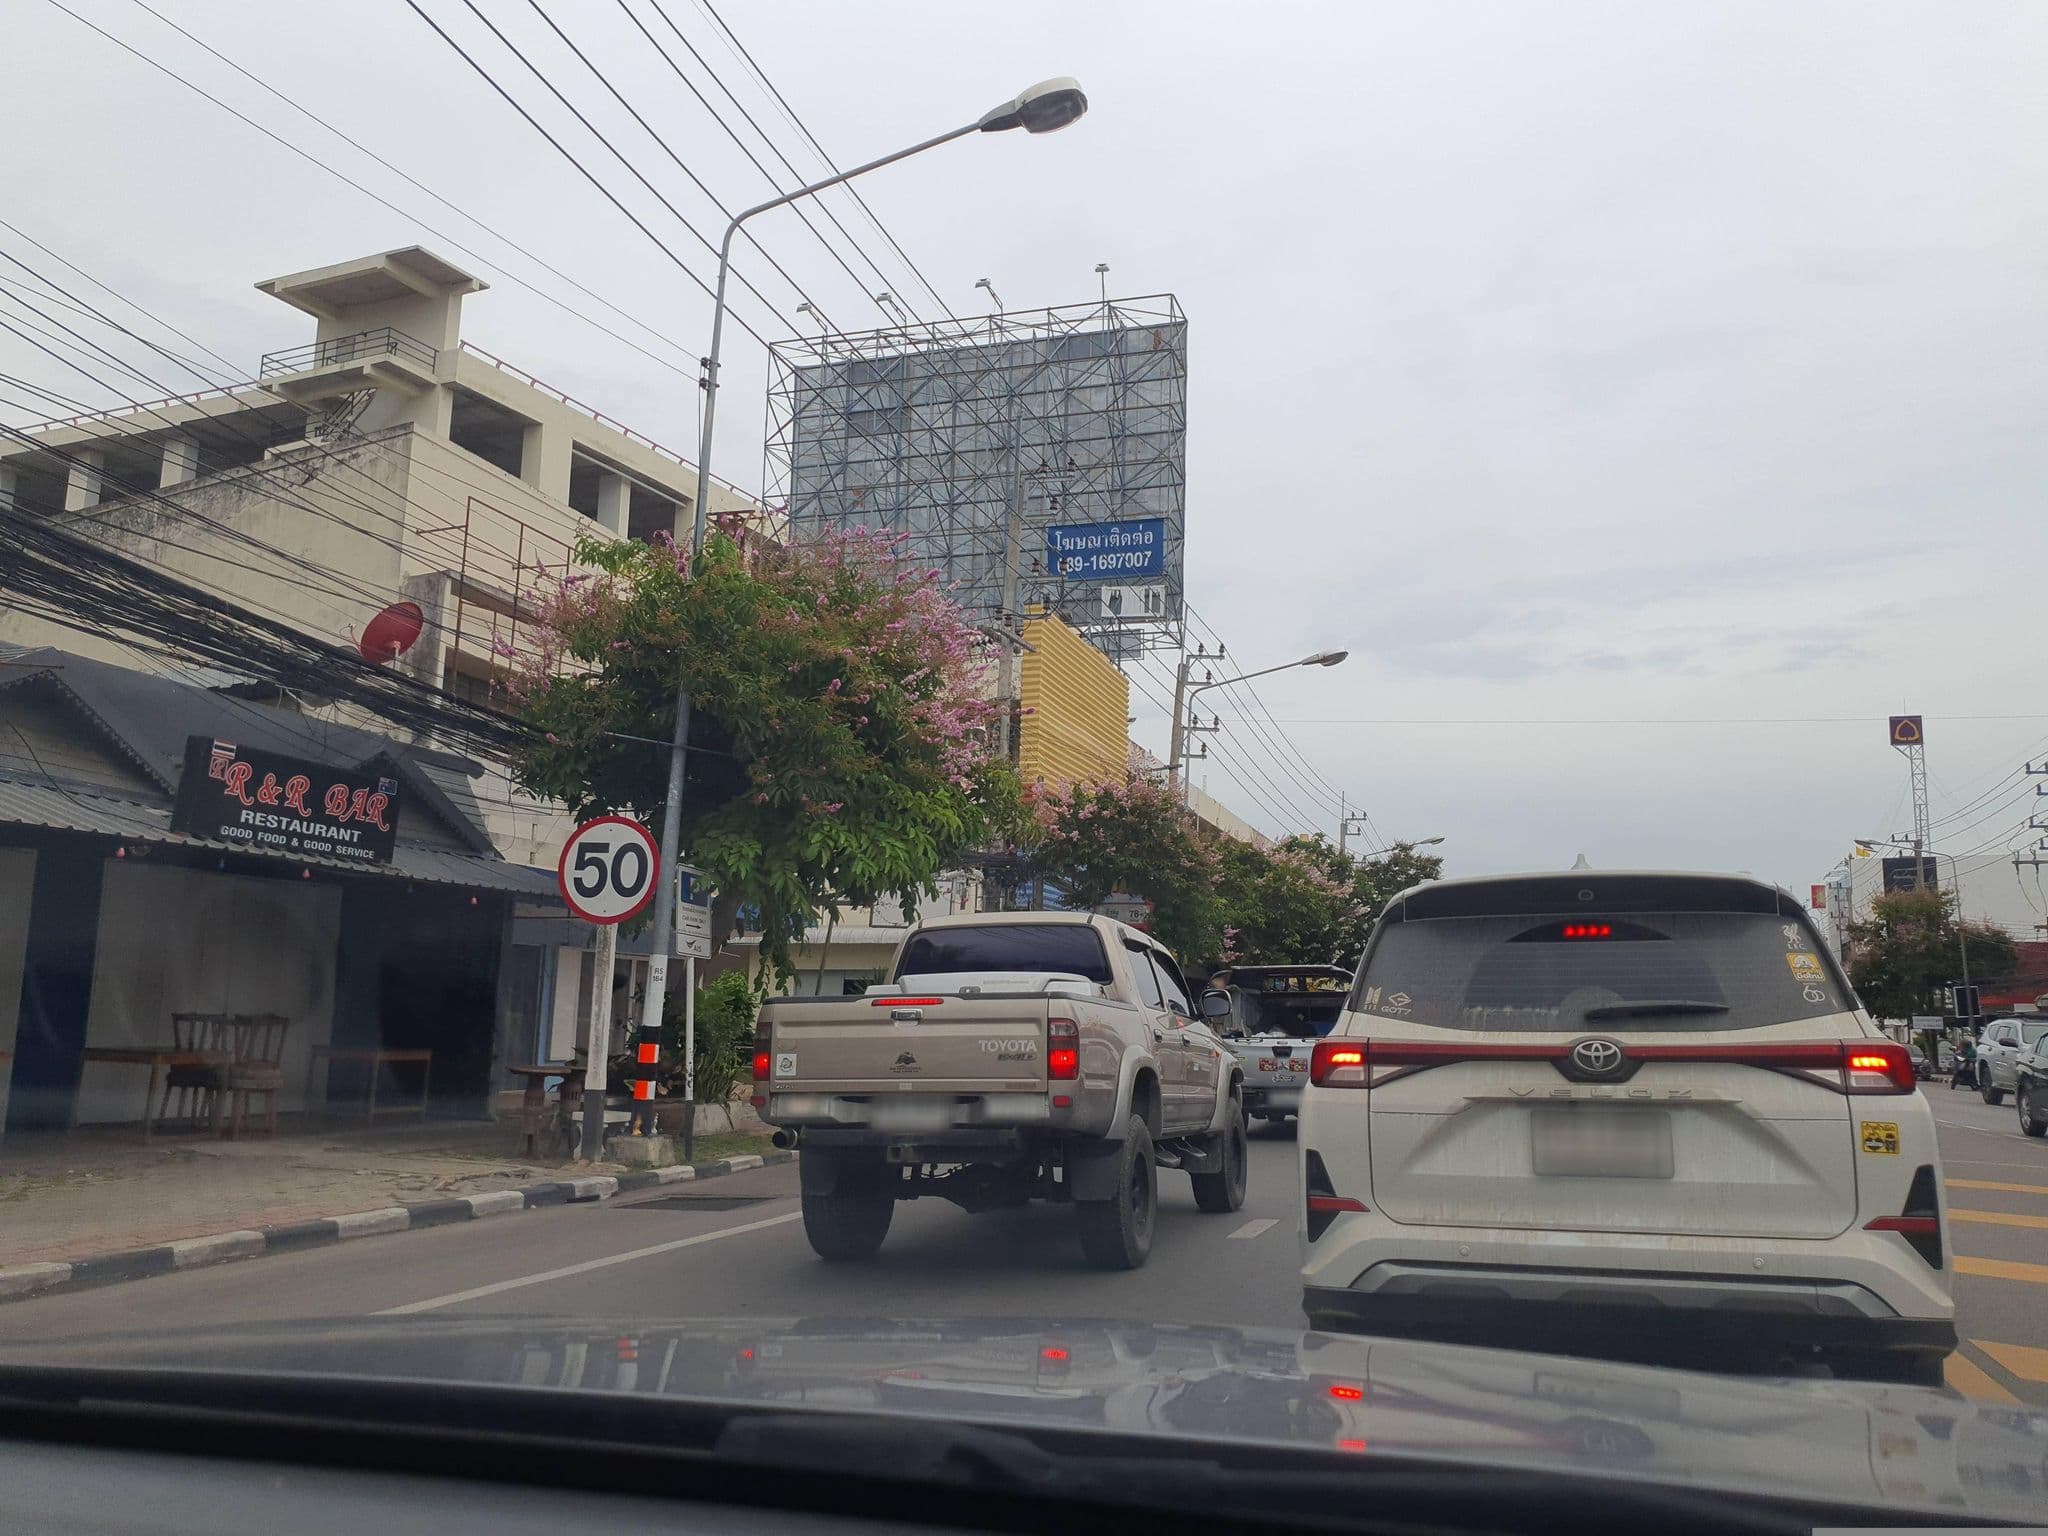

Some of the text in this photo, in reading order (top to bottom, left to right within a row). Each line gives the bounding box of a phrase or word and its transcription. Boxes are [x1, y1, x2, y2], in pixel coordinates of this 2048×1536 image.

[1054, 524, 1154, 551] โฆษณาติดต่อ
[324, 783, 390, 832] BAR
[240, 809, 362, 843] RESTAURANT
[220, 825, 376, 859] GOOD FOOD & GOOD SERVICE
[573, 841, 649, 898] 50
[1380, 1005, 1412, 1016] GOT7
[978, 1039, 1038, 1053] TOYOTA
[1508, 1087, 1692, 1099] VELOZ
